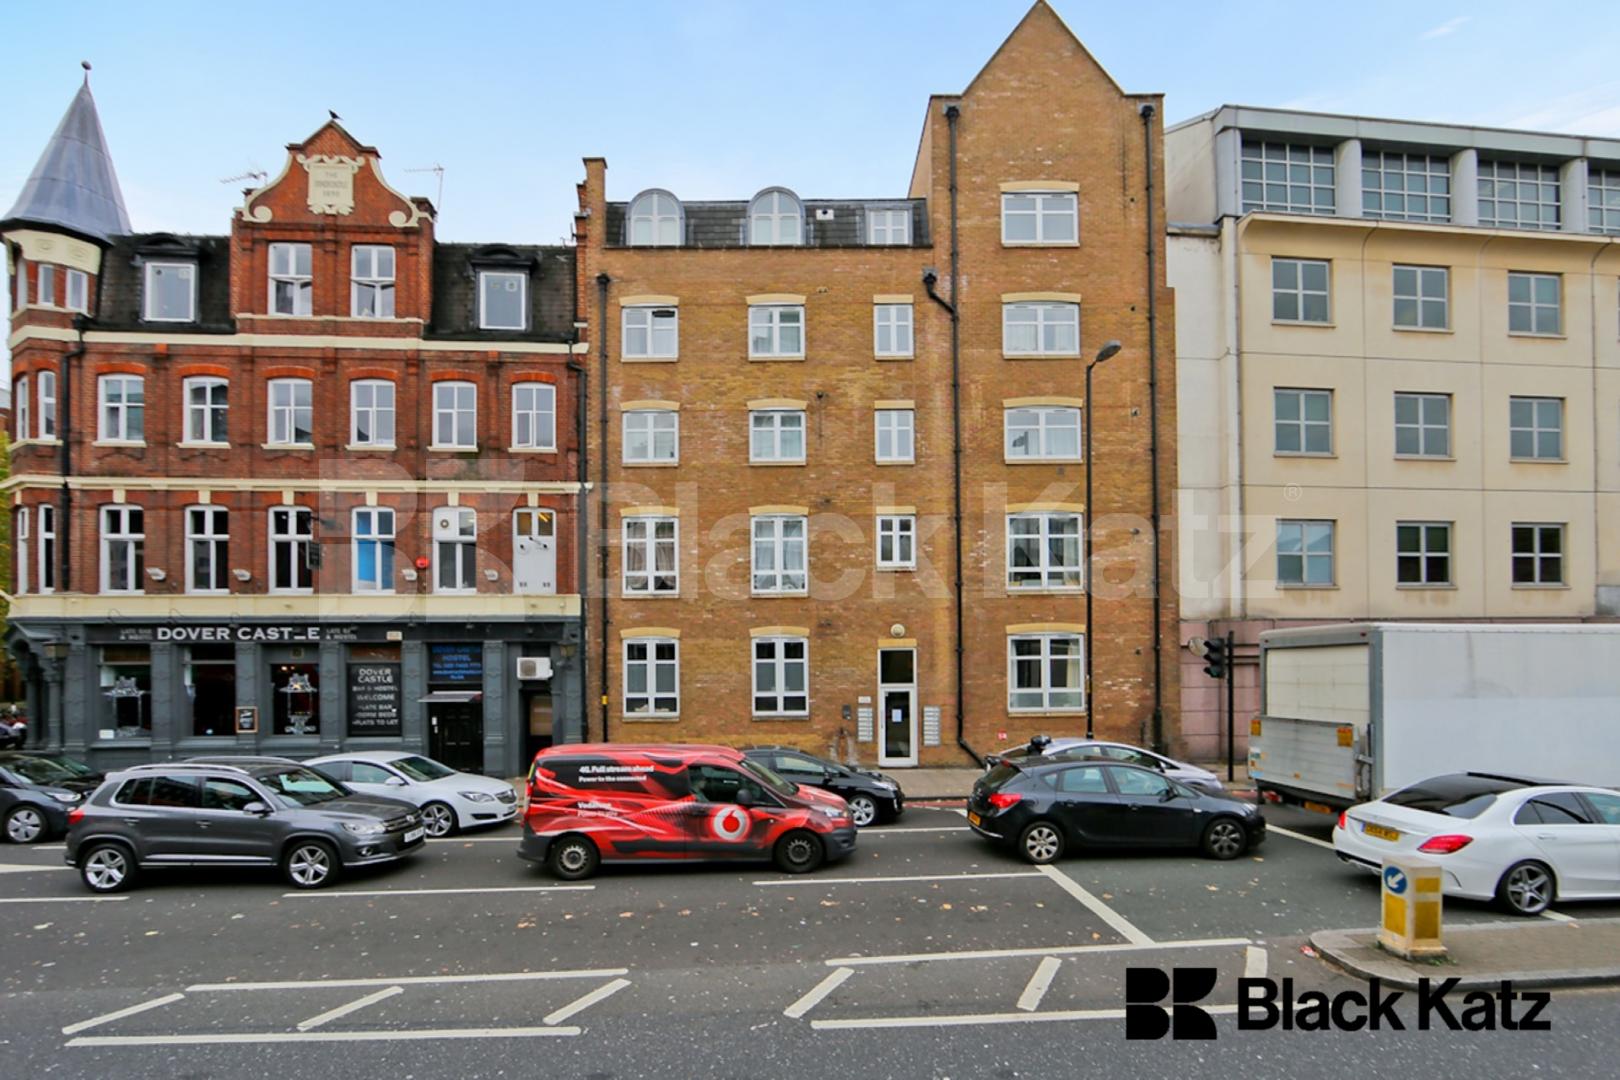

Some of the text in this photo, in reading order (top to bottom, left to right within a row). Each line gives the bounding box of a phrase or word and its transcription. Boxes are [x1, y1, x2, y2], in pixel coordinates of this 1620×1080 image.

[156, 627, 230, 641] DOVER
[358, 668, 392, 676] DOVER
[357, 675, 394, 683] CASTLE
